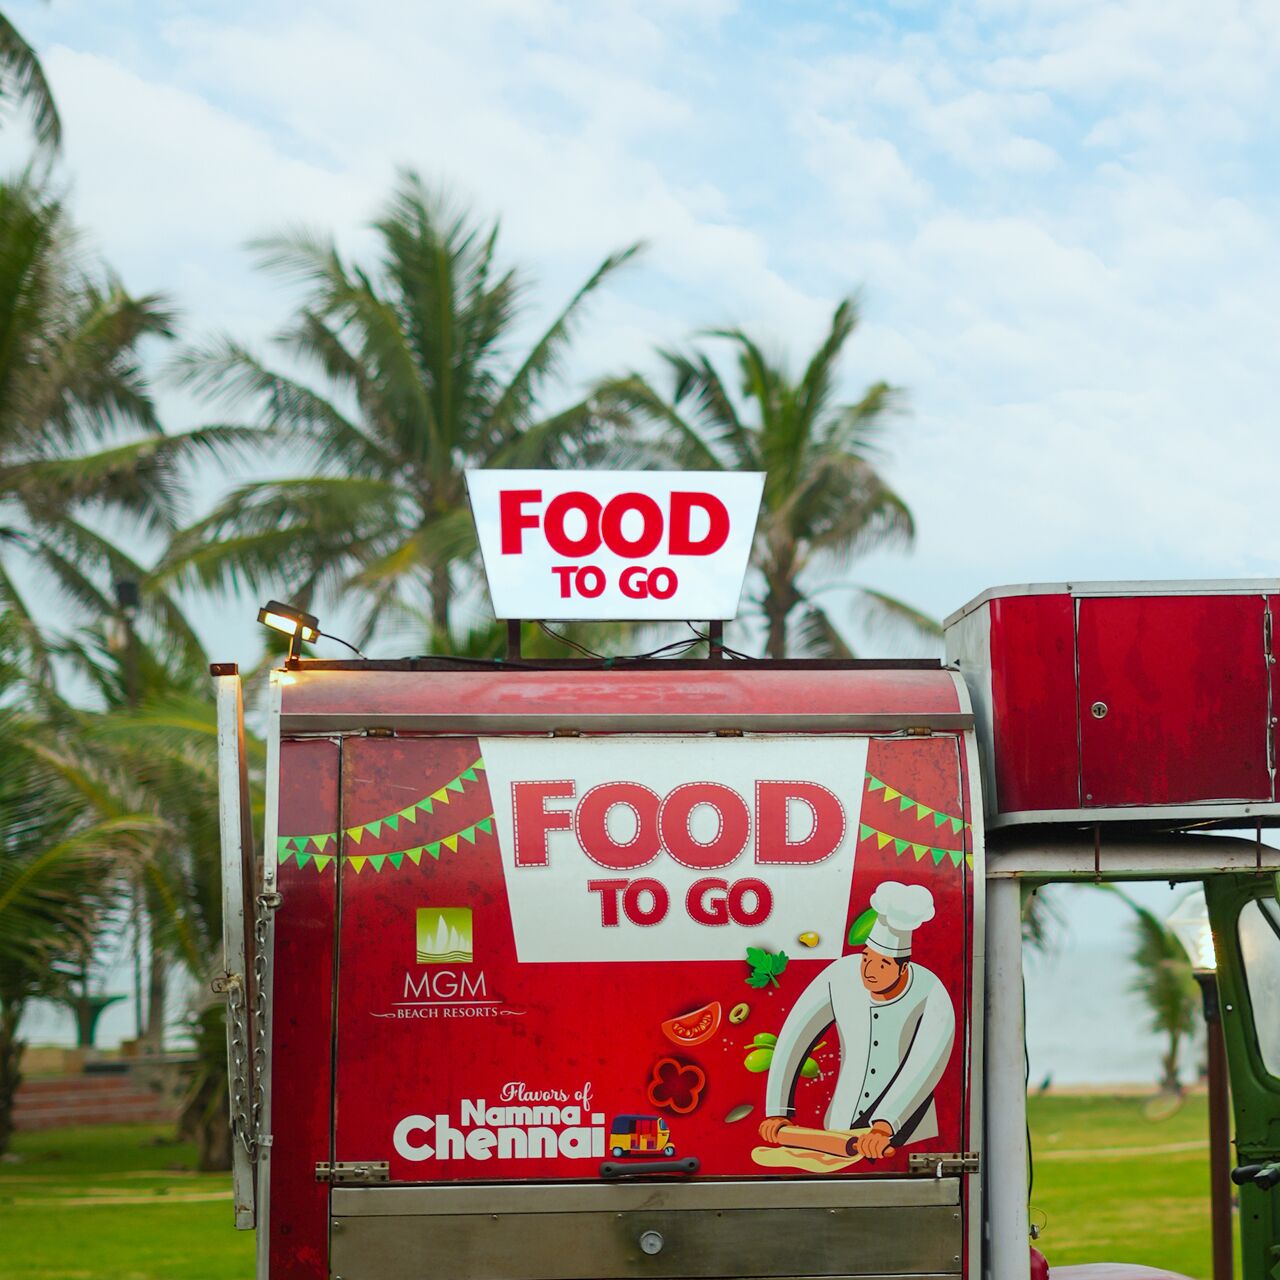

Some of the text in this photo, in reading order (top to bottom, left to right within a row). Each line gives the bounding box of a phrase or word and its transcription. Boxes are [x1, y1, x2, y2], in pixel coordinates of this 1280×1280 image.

[499, 489, 730, 559] FOOD
[552, 566, 679, 600] TO GO
[511, 780, 847, 870] FOOD
[588, 877, 773, 928] TO GO
[403, 970, 487, 998] MGM
[396, 1006, 498, 1019] BEACH RESORTS
[461, 1098, 581, 1126] Namma
[500, 1081, 594, 1111] Flavors of
[393, 1112, 605, 1162] Chennai
